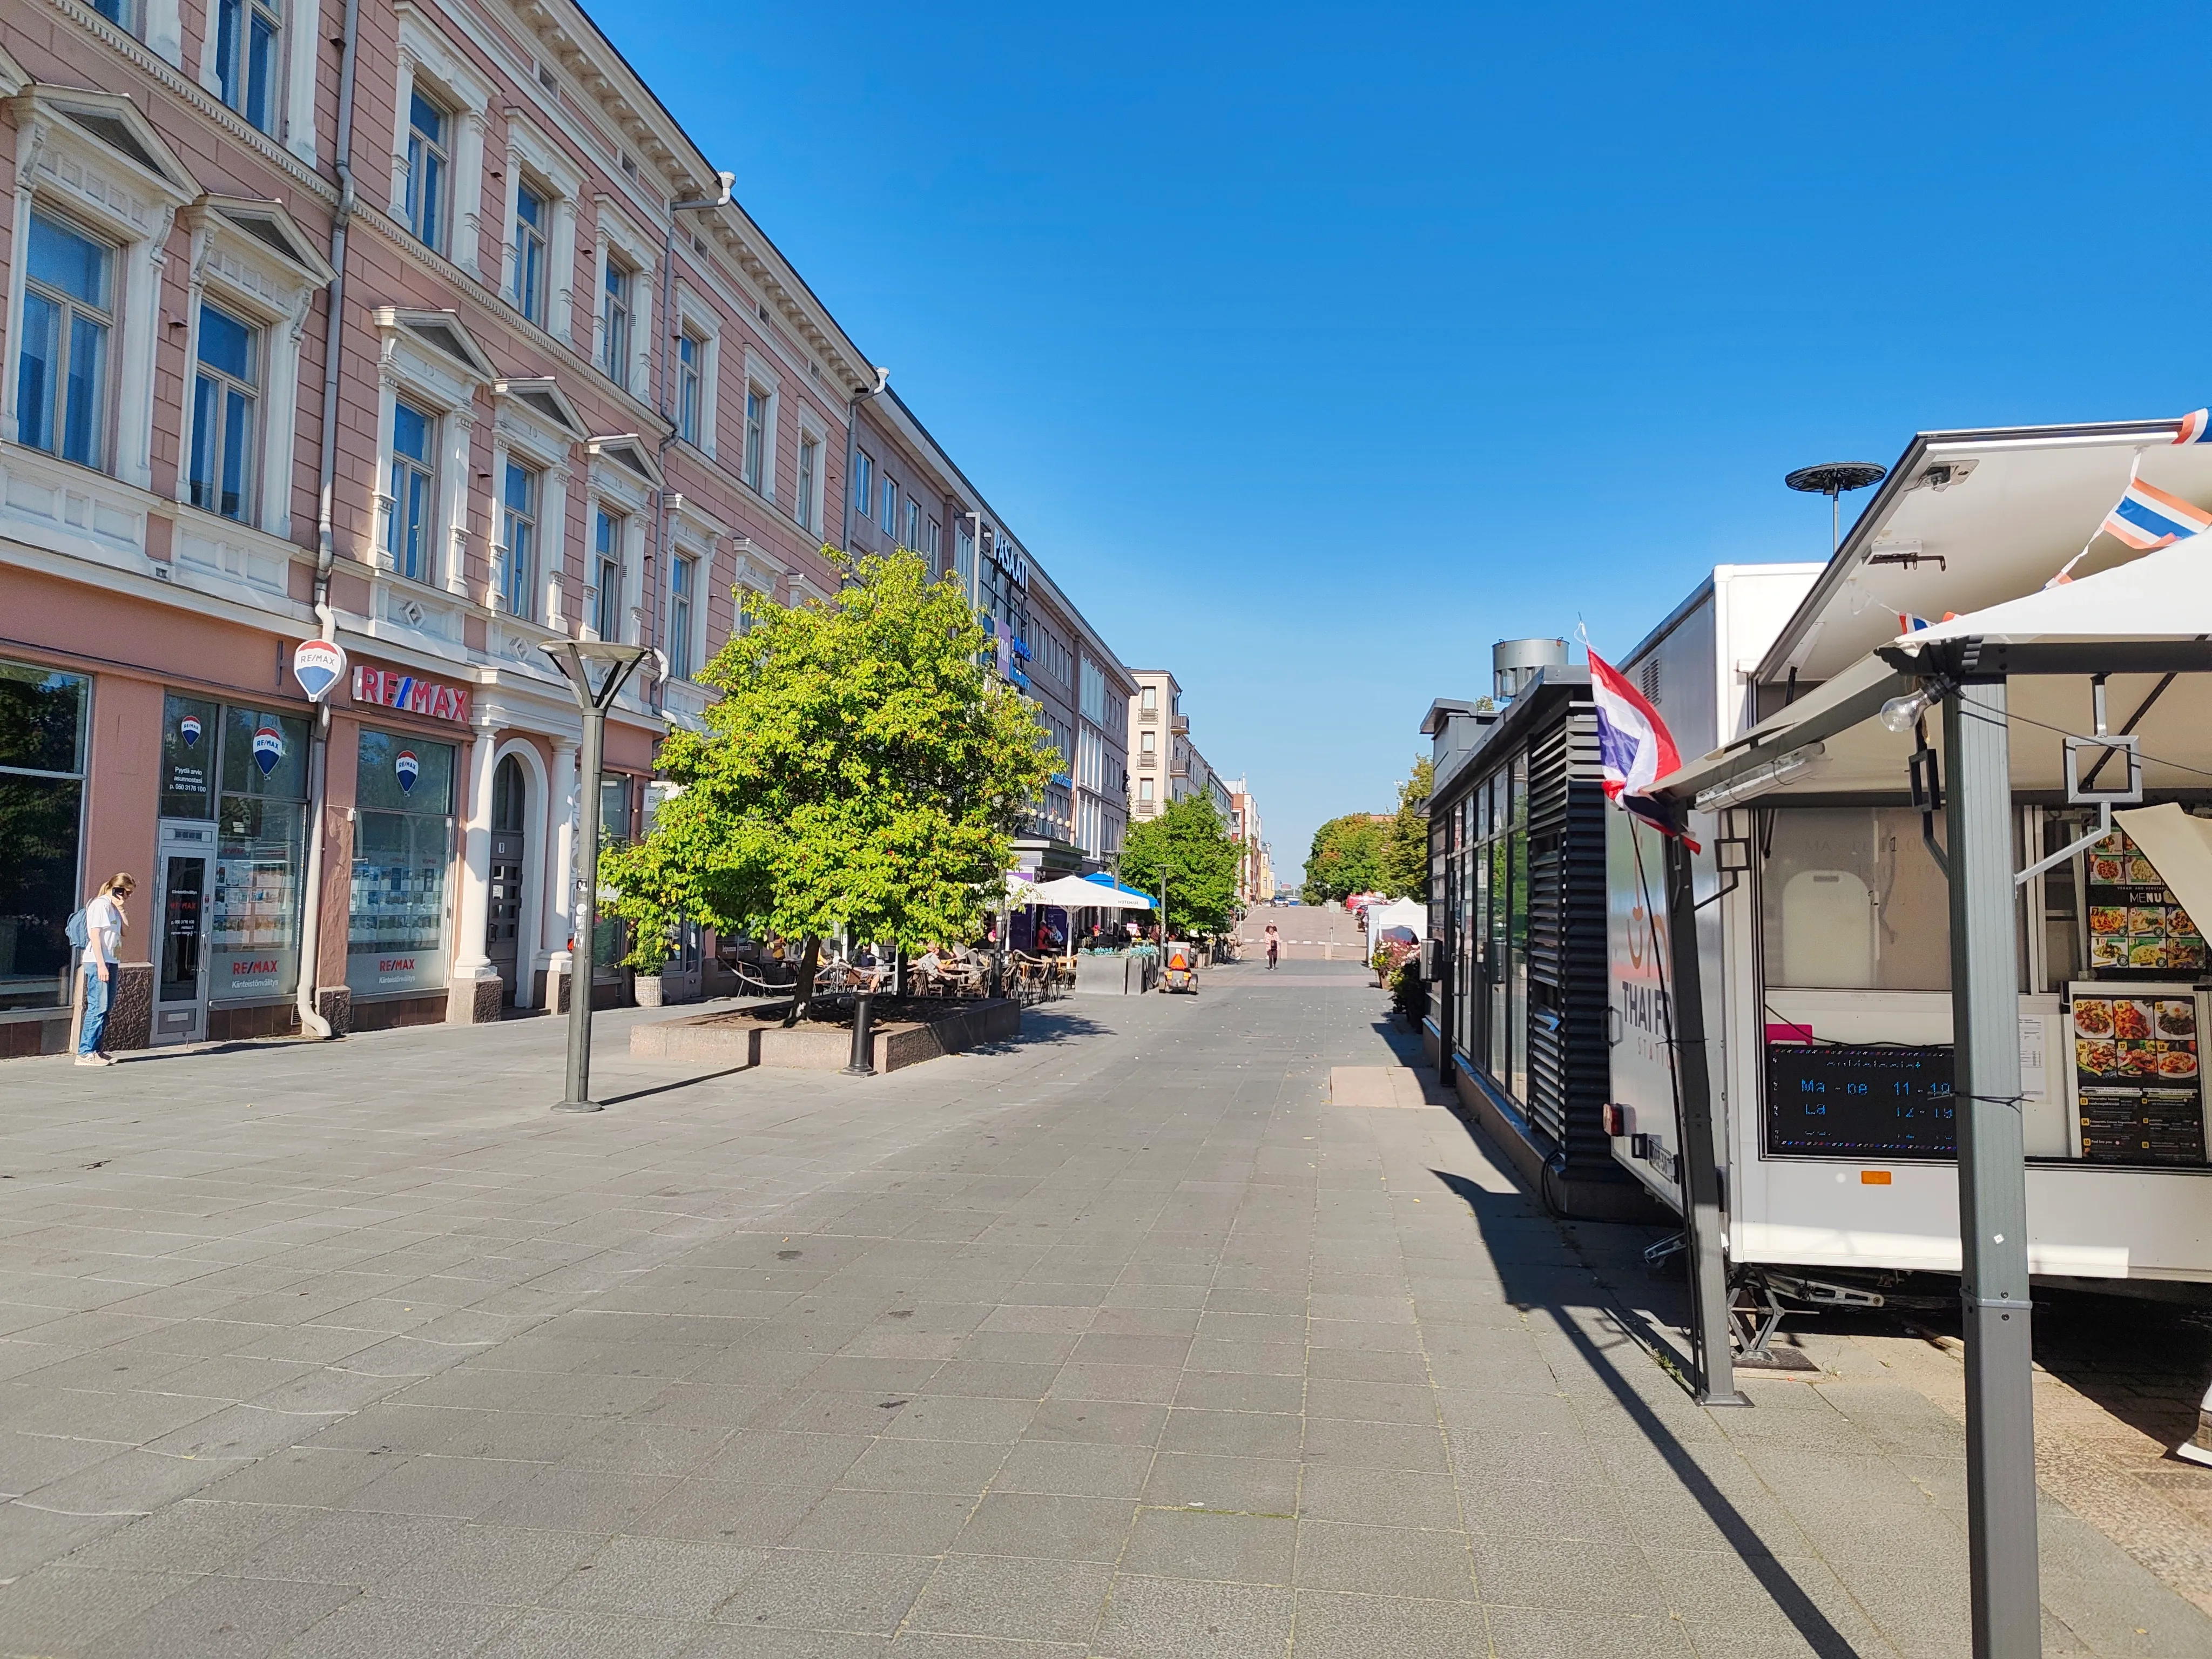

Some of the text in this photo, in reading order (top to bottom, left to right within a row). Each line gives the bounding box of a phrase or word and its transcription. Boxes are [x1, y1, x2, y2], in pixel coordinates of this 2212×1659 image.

[994, 527, 1028, 593] PASAATI
[301, 654, 335, 665] RE/MAX
[362, 666, 468, 723] RE/MAX
[257, 740, 279, 750] RE/MAX
[399, 761, 416, 771] RE/MAX
[2130, 892, 2162, 903] MENU
[2130, 908, 2137, 916] 8
[233, 961, 278, 975] RE/MAX
[380, 959, 415, 972] RE/MAX
[1622, 980, 1651, 1033] THAI
[1894, 1082, 1909, 1096] 11
